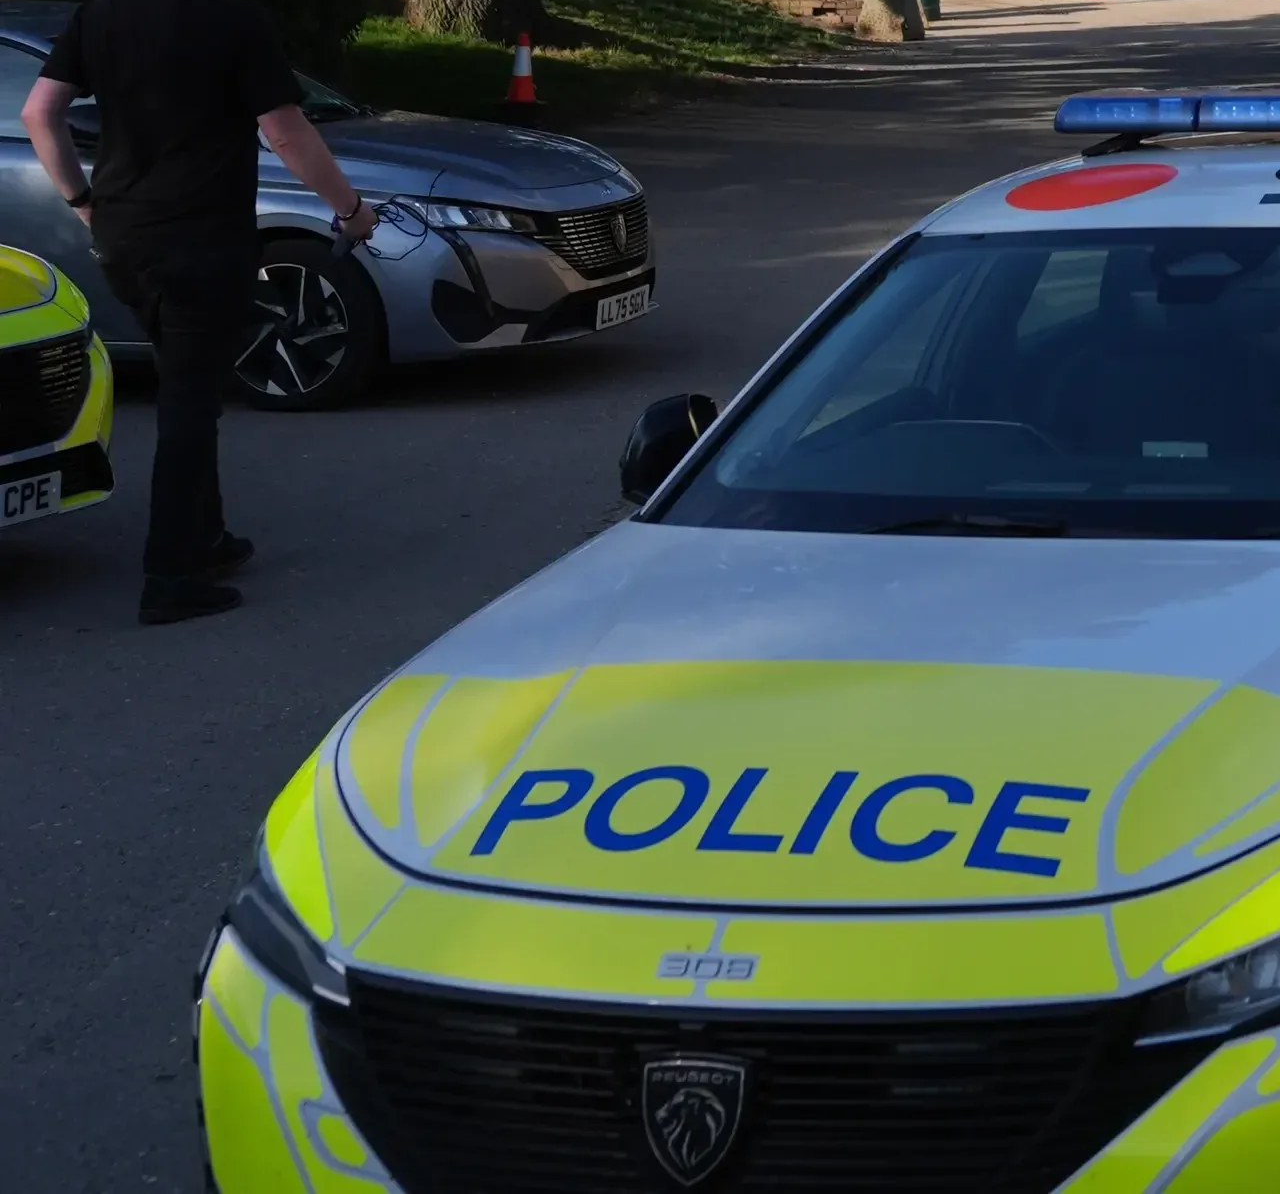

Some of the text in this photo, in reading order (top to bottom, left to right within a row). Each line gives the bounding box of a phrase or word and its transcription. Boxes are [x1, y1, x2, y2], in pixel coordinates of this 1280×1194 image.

[4, 477, 51, 518] CPE
[469, 765, 1091, 878] POLICE
[658, 957, 755, 980] 308
[652, 1070, 736, 1086] PEUGEOT
